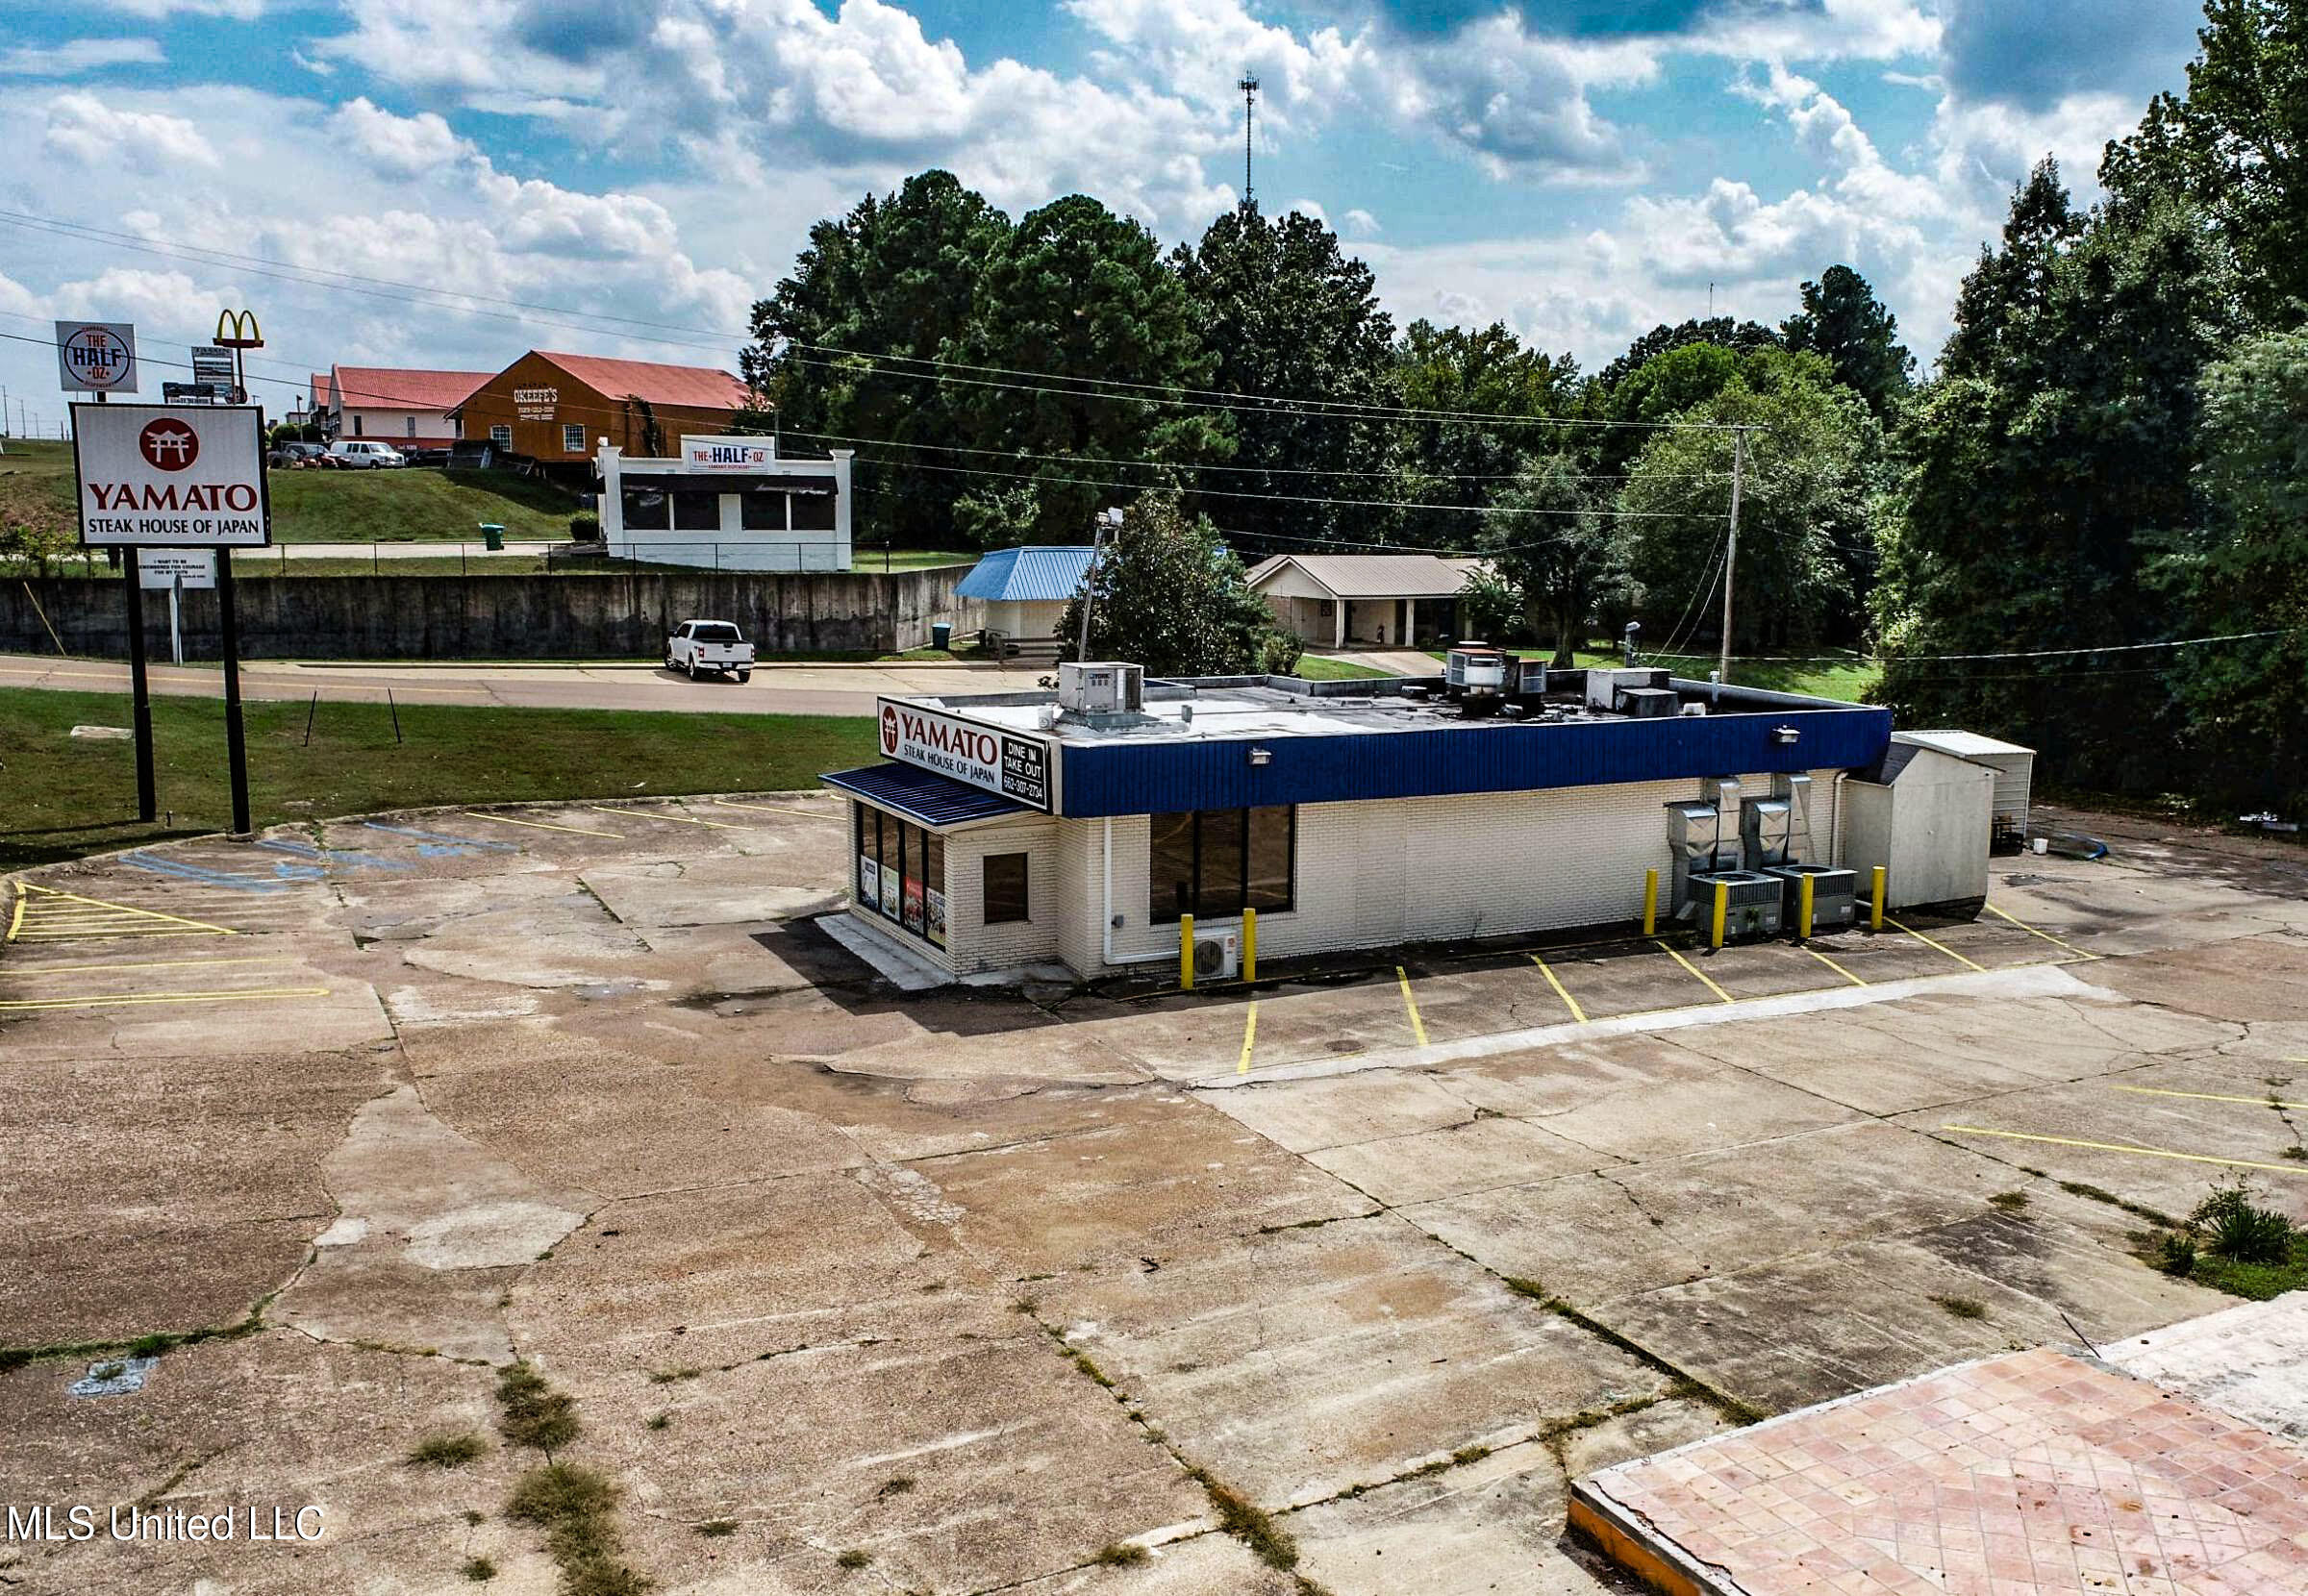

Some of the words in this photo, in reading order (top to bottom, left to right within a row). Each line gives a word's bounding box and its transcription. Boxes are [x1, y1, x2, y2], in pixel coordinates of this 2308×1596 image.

[87, 335, 107, 347] THE
[72, 347, 121, 366] HALF
[92, 367, 107, 379] OZ
[693, 451, 708, 461] THE
[713, 447, 748, 463] HALF
[753, 452, 765, 461] OZ
[88, 484, 257, 511] YAMATO
[88, 519, 134, 533] STEAK
[139, 519, 188, 533] HOUSE
[192, 519, 212, 533] OF
[217, 520, 259, 536] JAPAN
[901, 712, 998, 765] YAMATO
[1008, 741, 1026, 760] DINE
[1028, 748, 1037, 762] IN
[904, 744, 925, 762] STEAK
[927, 752, 954, 771] HOUSE
[956, 761, 968, 774] OF
[969, 764, 994, 785] JAPAN
[1003, 755, 1022, 773] TAKE
[1024, 761, 1042, 779] OUT
[1003, 775, 1042, 800] 662-307-2734
